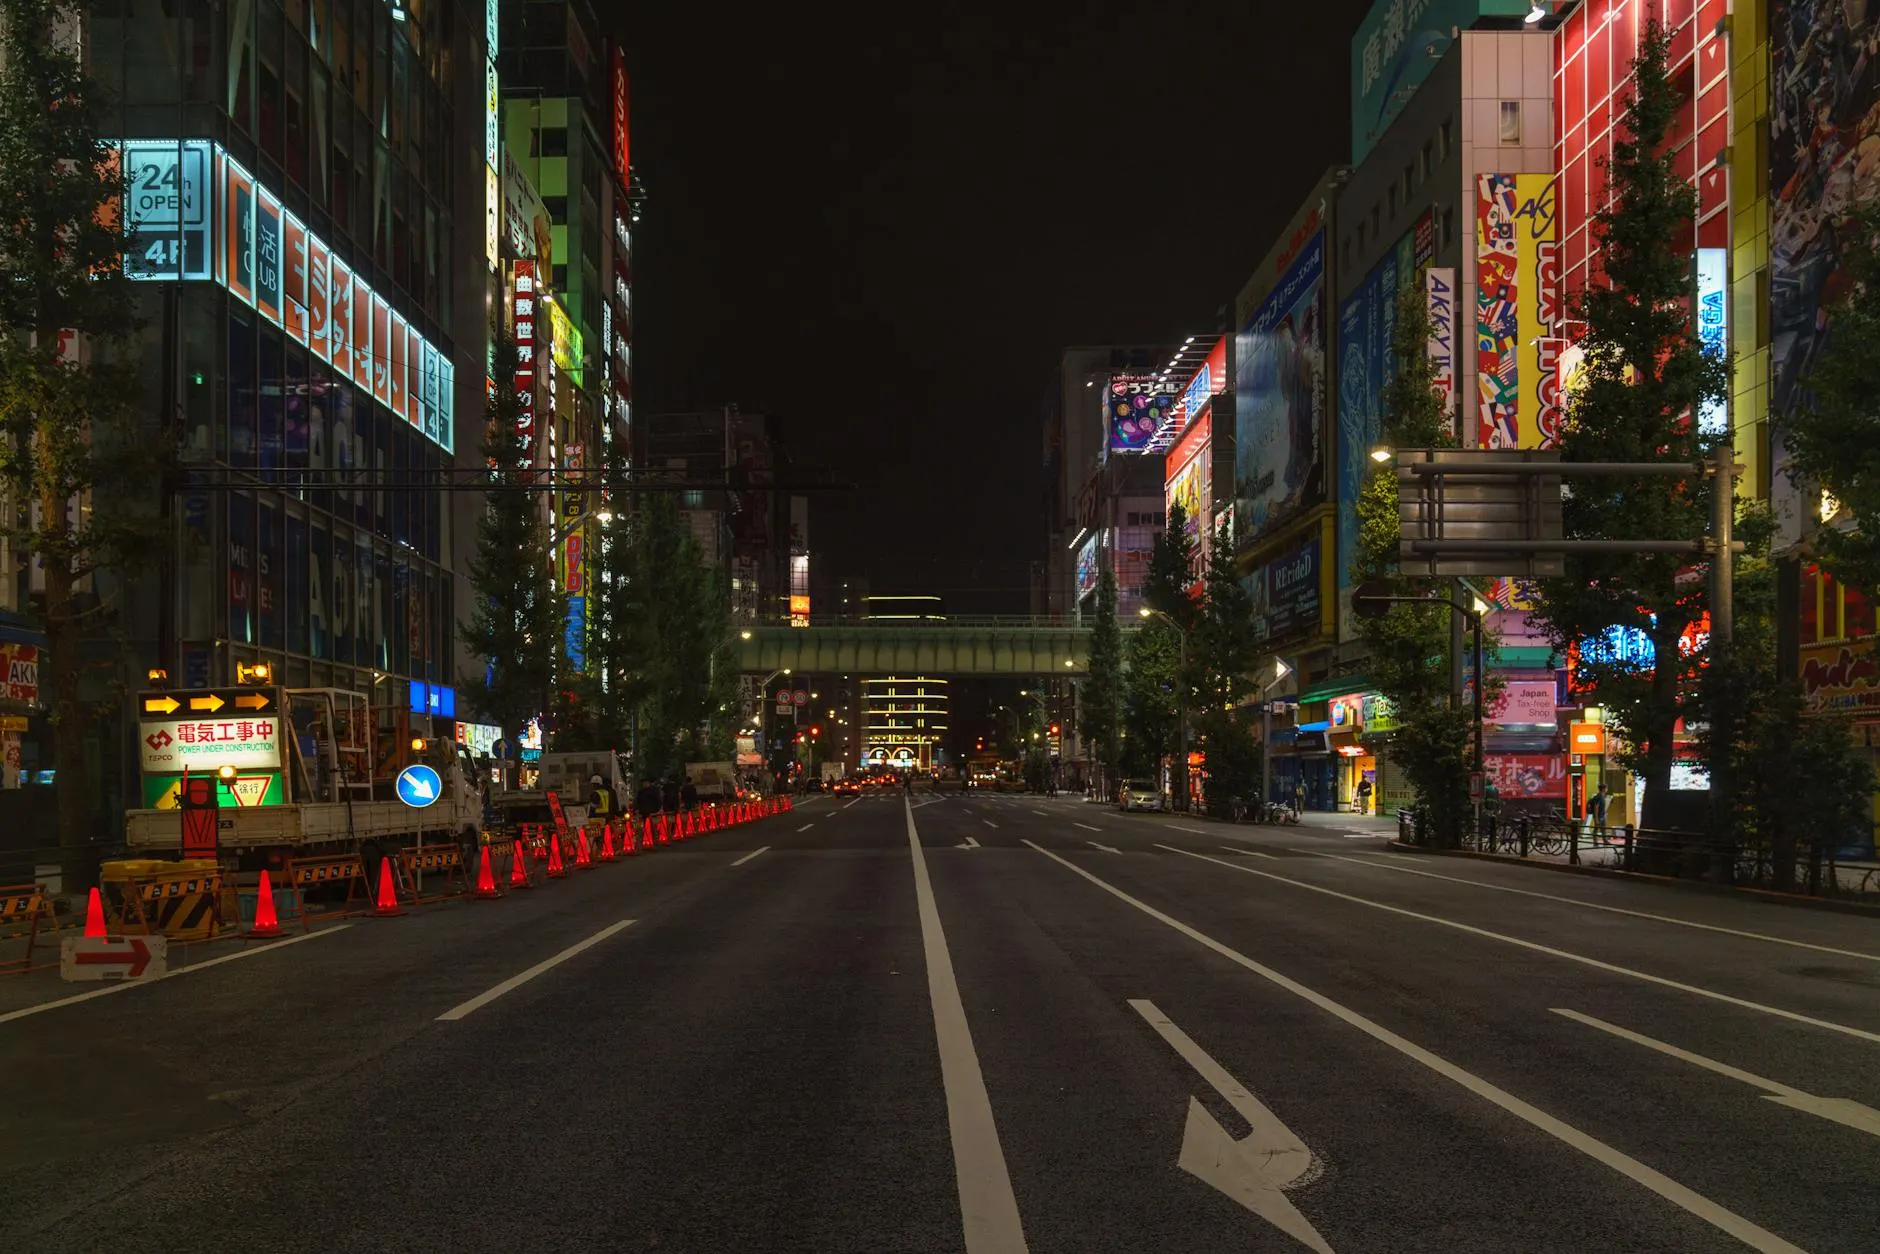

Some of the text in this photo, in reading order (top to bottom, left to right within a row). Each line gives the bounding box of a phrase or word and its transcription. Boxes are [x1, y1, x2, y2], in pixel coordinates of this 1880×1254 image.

[142, 163, 191, 190] 24h
[140, 195, 191, 210] OPEN
[145, 239, 187, 265] 4F
[244, 250, 277, 292] CUB
[1431, 274, 1450, 351] AKKY
[567, 535, 582, 592] DVD
[1516, 700, 1550, 708] Tax-free
[1529, 709, 1550, 717] Shop
[178, 720, 273, 743] 電気工事中
[178, 742, 274, 753] POWER UNDER CONSTRUCTION
[239, 784, 259, 794] 徐行
